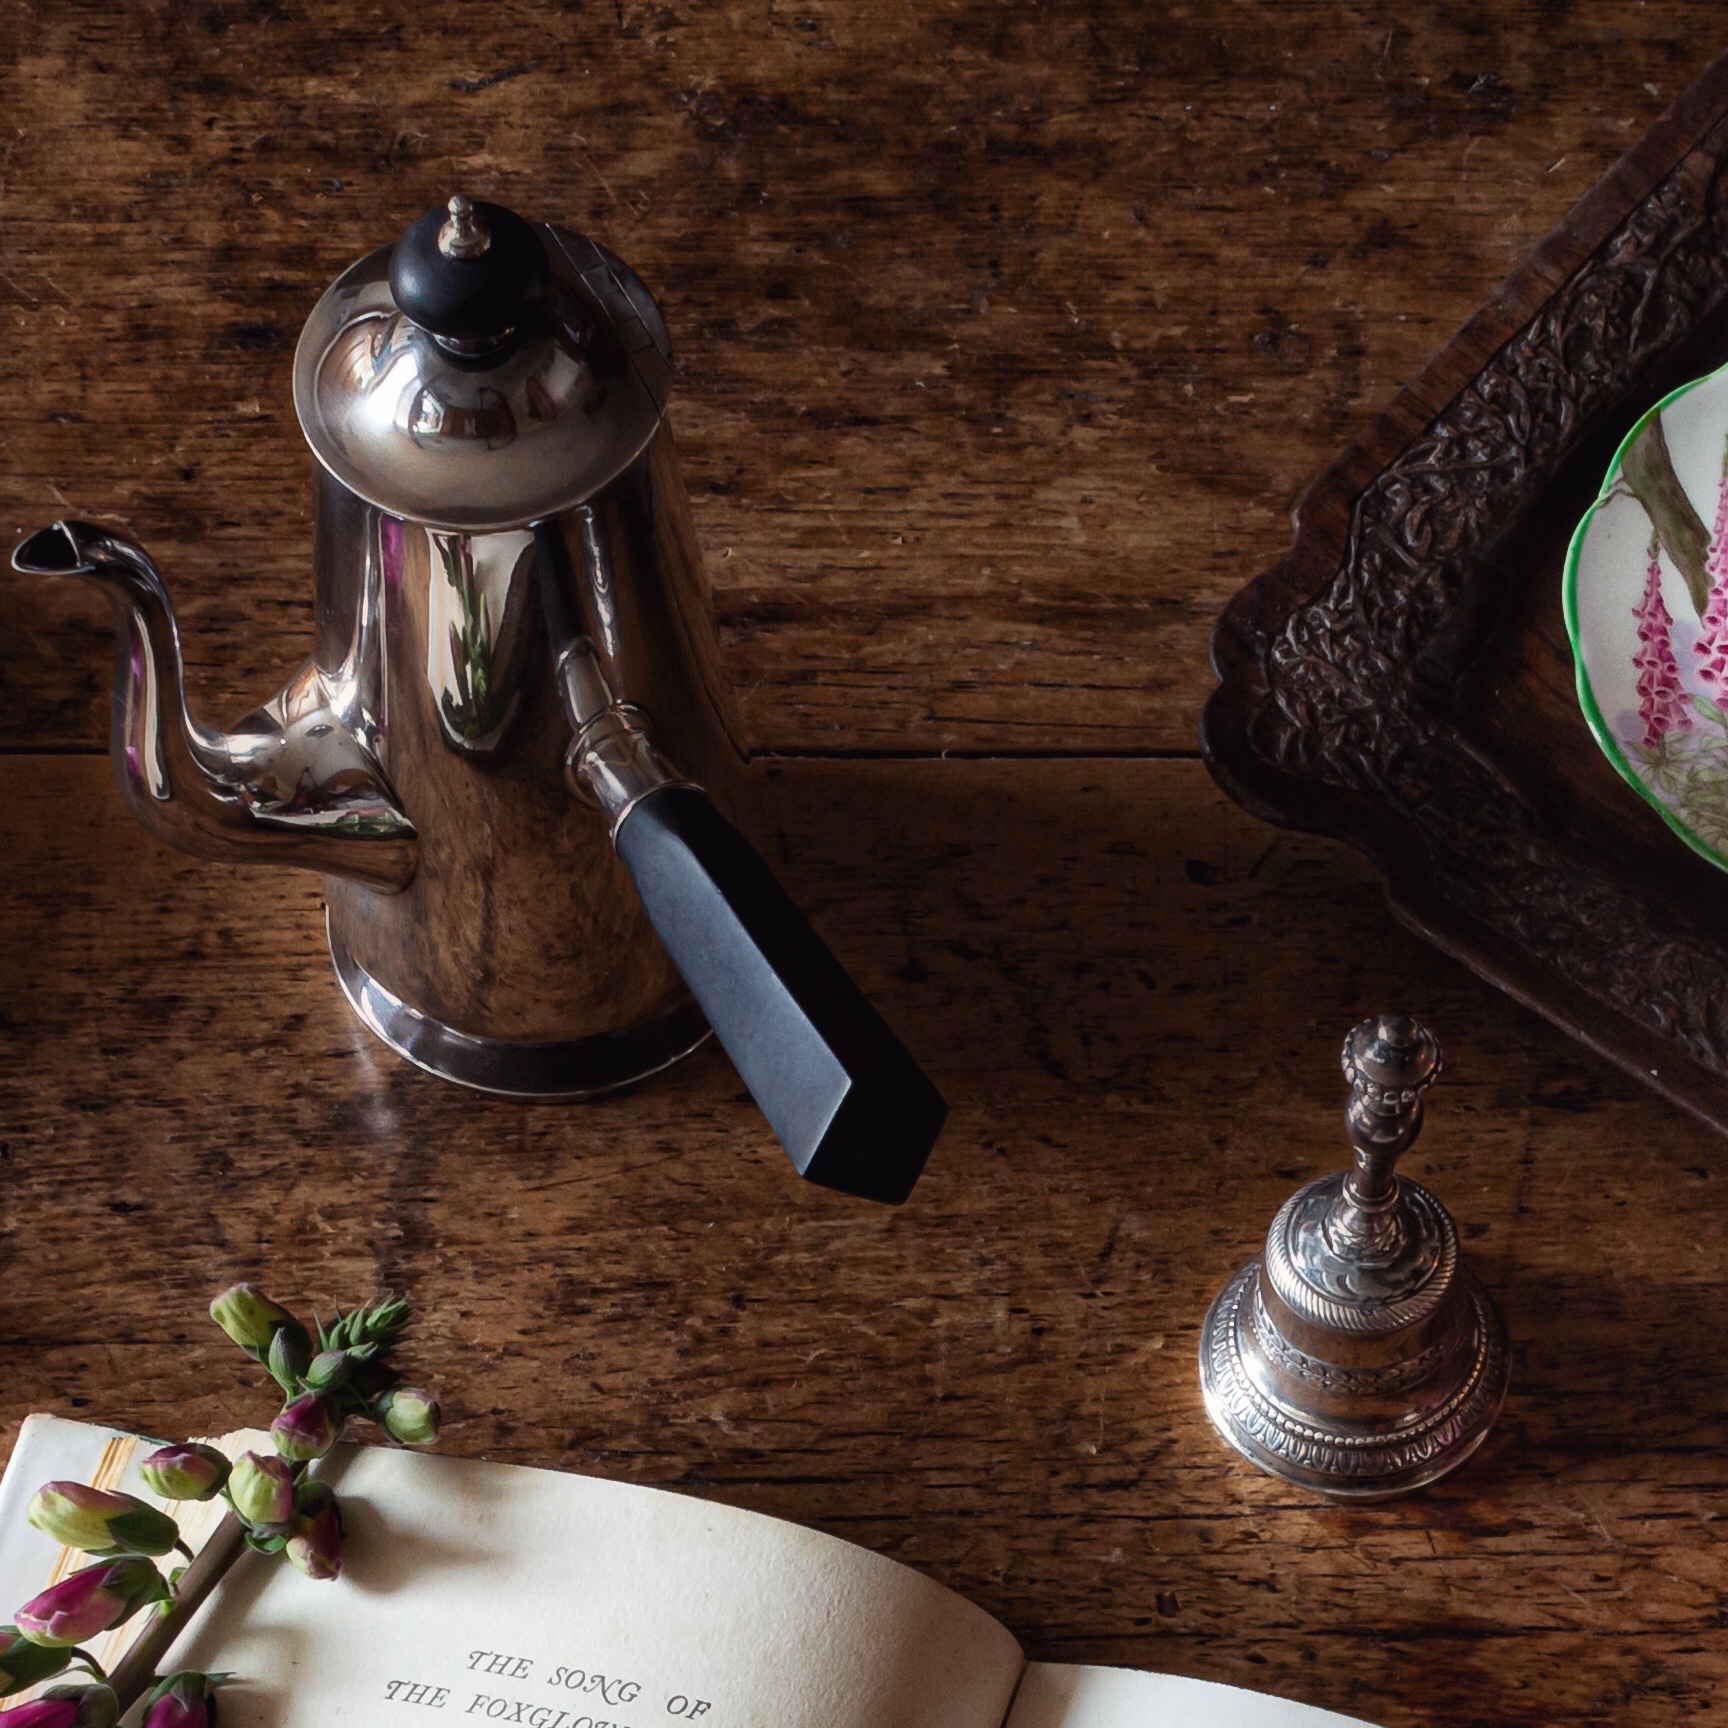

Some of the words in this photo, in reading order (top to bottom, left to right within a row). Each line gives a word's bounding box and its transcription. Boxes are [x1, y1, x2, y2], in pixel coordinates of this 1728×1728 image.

[383, 1679, 451, 1709] THE
[466, 1650, 534, 1680] THE
[546, 1666, 642, 1706] SONG
[666, 1694, 712, 1721] OF
